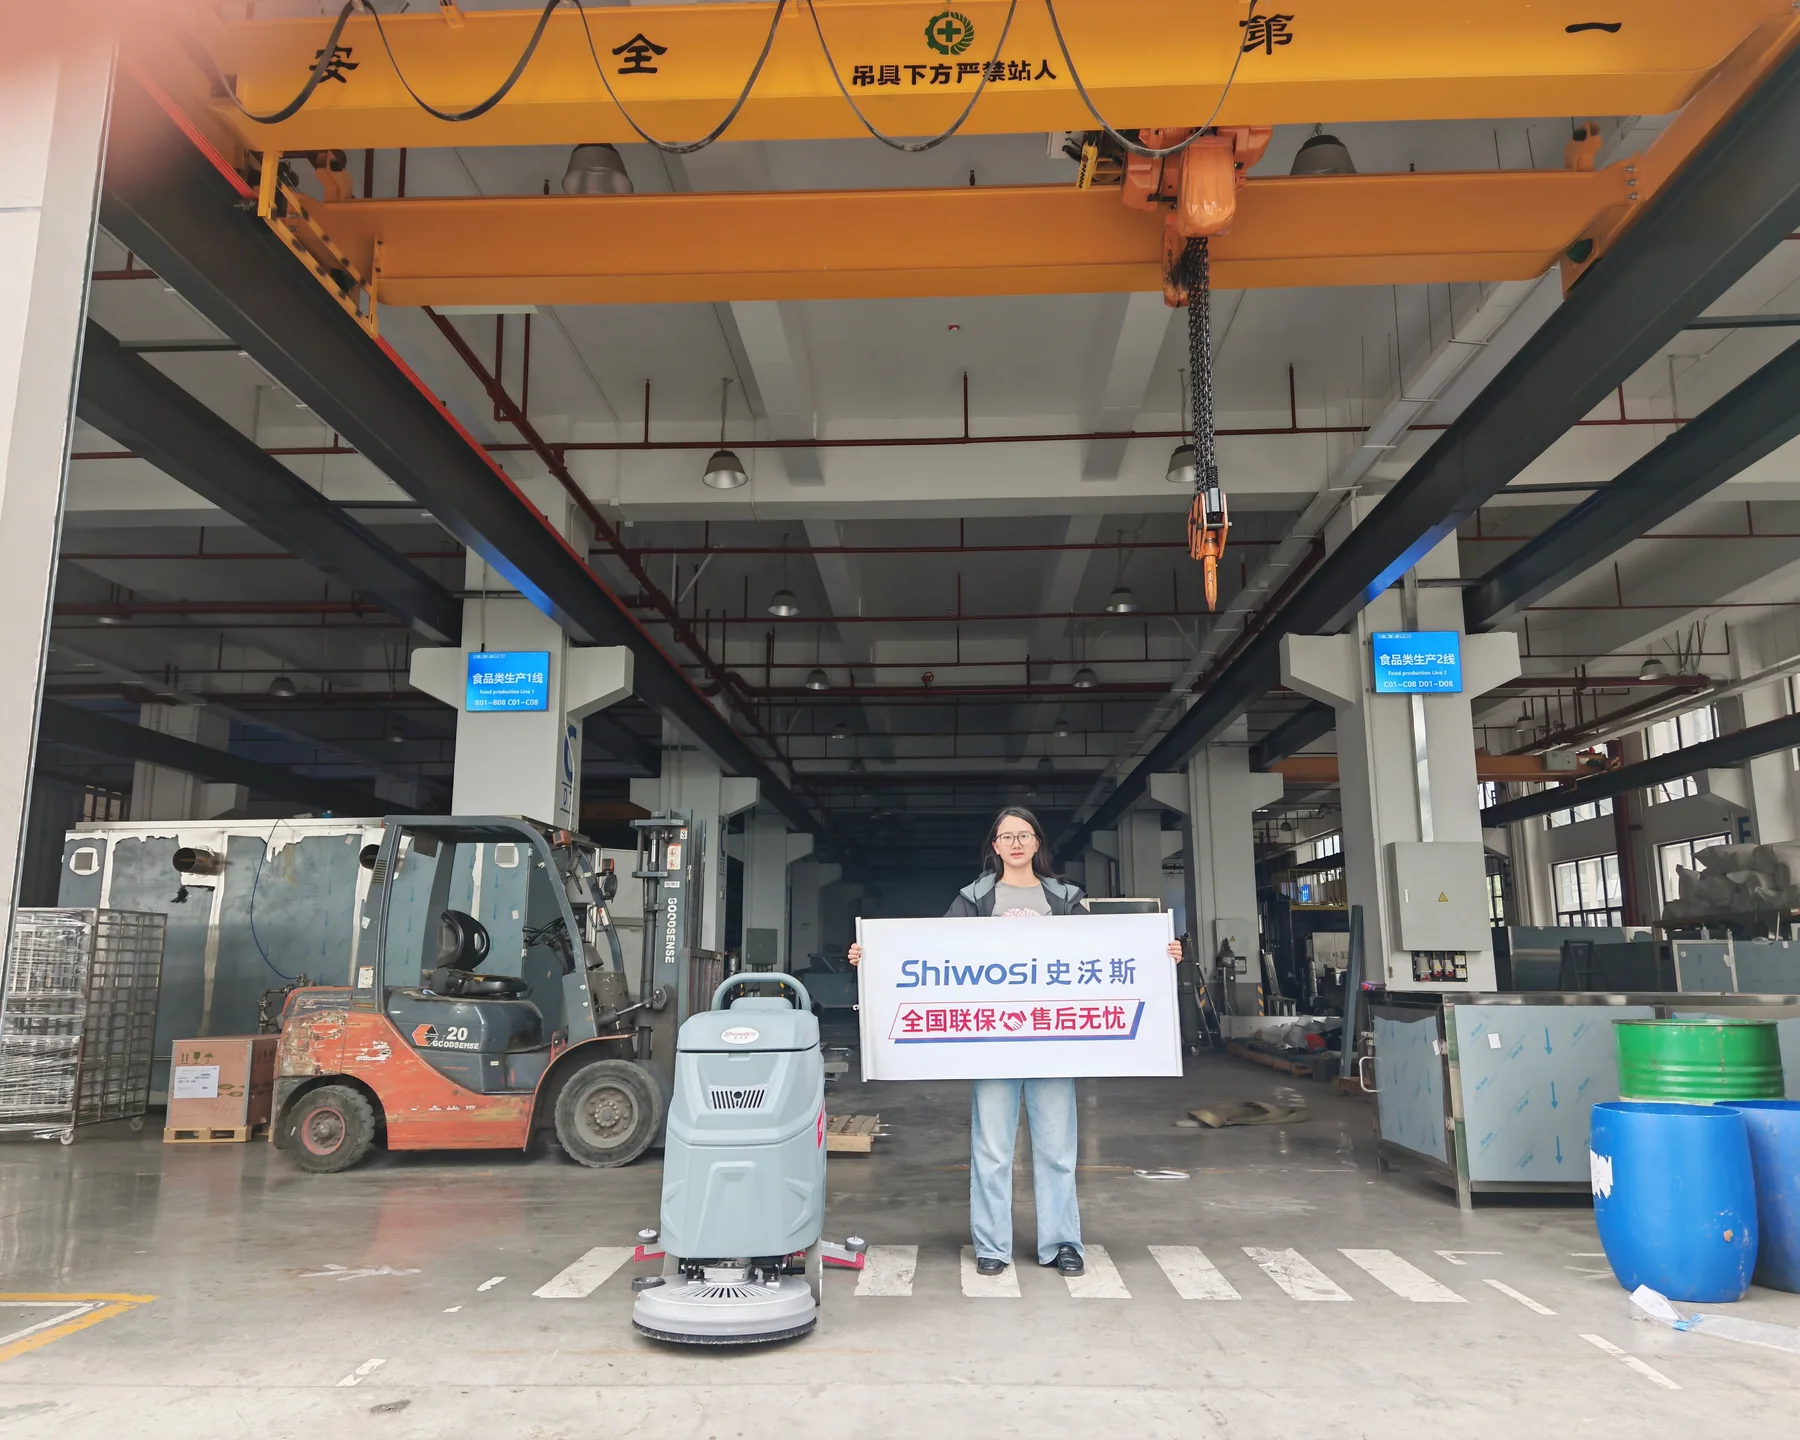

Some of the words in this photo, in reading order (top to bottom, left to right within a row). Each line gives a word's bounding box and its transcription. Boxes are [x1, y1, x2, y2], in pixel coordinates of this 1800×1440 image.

[308, 45, 360, 84] 安
[611, 33, 669, 75] 全
[1239, 13, 1295, 56] 第
[1564, 21, 1623, 34] 一
[851, 59, 1058, 87] 吊具下方严禁站人
[1379, 653, 1456, 666] 食品类生产2线
[472, 672, 544, 685] 食品类生产1线
[664, 896, 678, 965] GOODSENSE
[896, 957, 1038, 988] Shiwosi
[1045, 956, 1137, 986] 史沃斯
[901, 1007, 997, 1033] 全国联保
[1029, 1005, 1126, 1032] 售后无忧
[446, 1026, 469, 1041] 20
